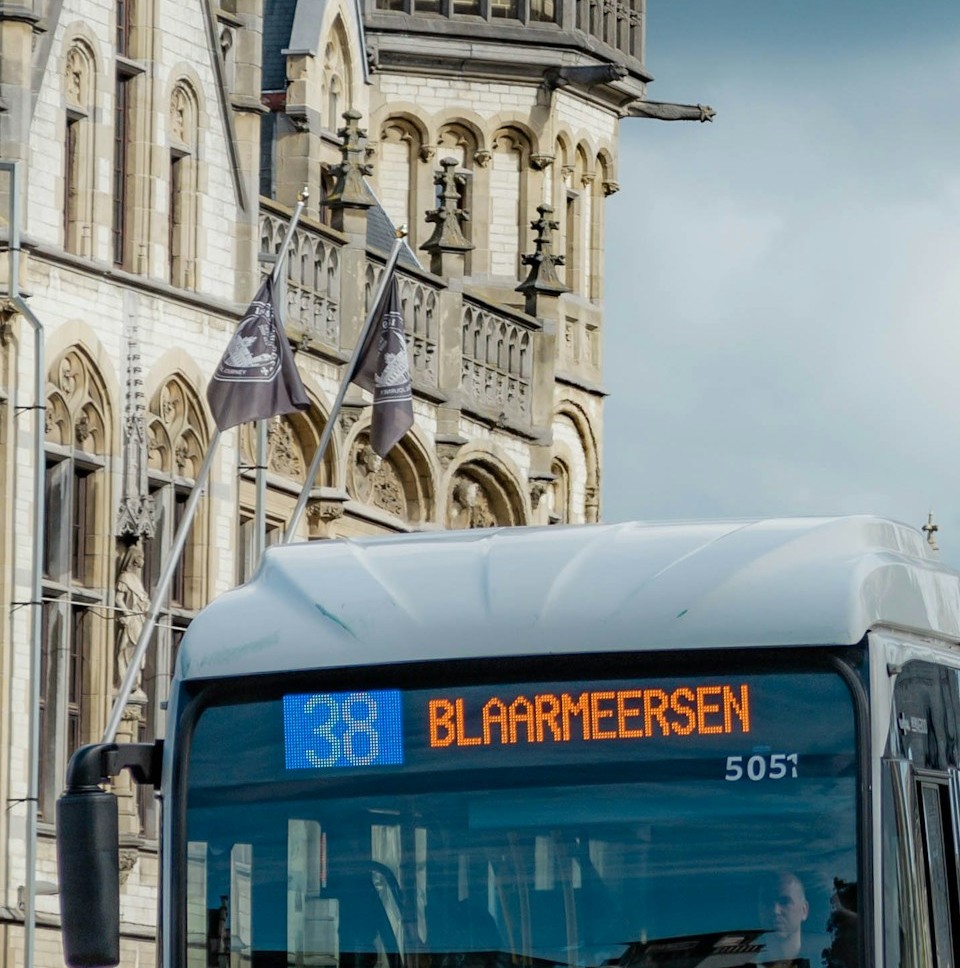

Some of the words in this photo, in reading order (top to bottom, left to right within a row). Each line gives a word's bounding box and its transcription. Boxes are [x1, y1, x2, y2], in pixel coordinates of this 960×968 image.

[303, 692, 379, 768] 38
[427, 684, 751, 748] BLAARMEERSEN
[725, 753, 798, 781] 5051
